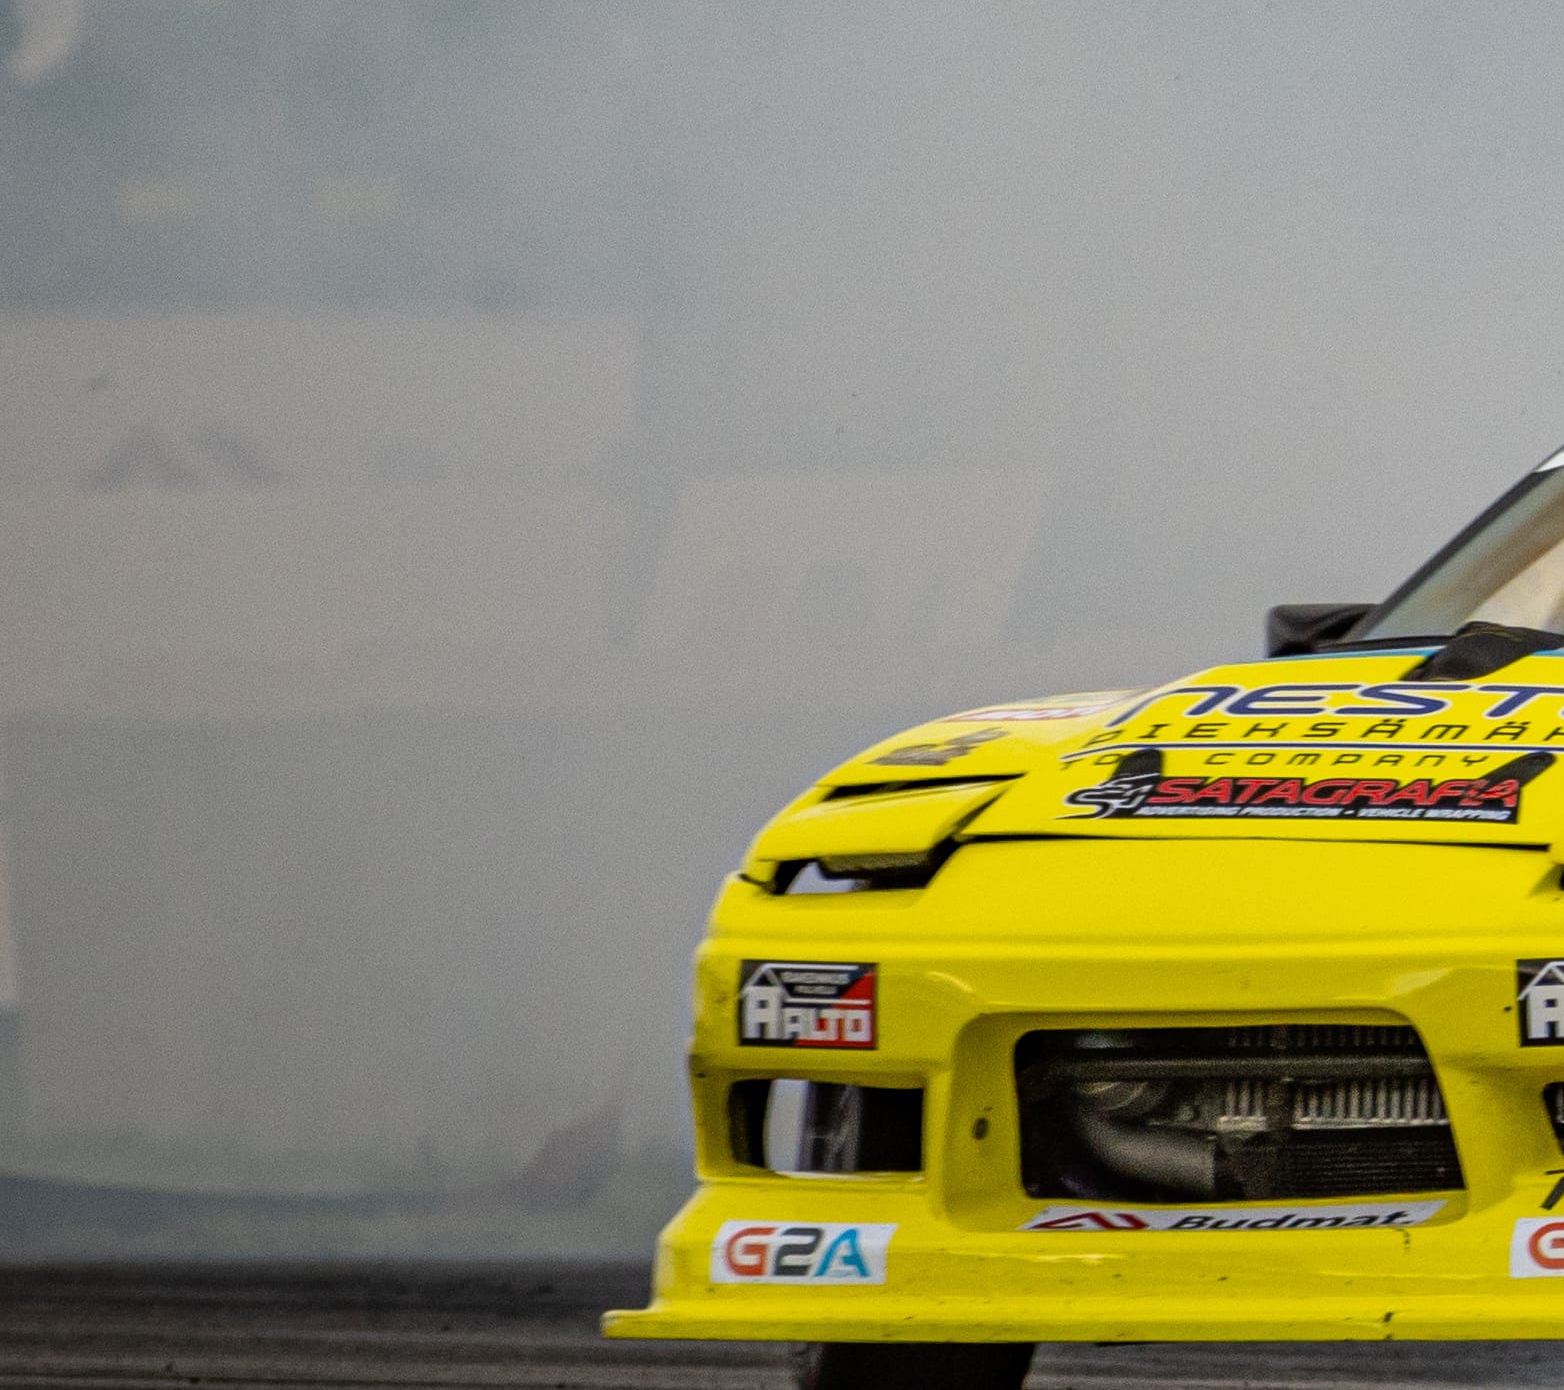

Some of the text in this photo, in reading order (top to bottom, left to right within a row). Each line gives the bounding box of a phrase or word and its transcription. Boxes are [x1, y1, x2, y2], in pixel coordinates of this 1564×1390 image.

[1204, 752, 1490, 768] COMPANY
[741, 985, 873, 1042] AALTO
[1160, 1208, 1413, 1232] Budmat.
[724, 1226, 870, 1277] G2A
